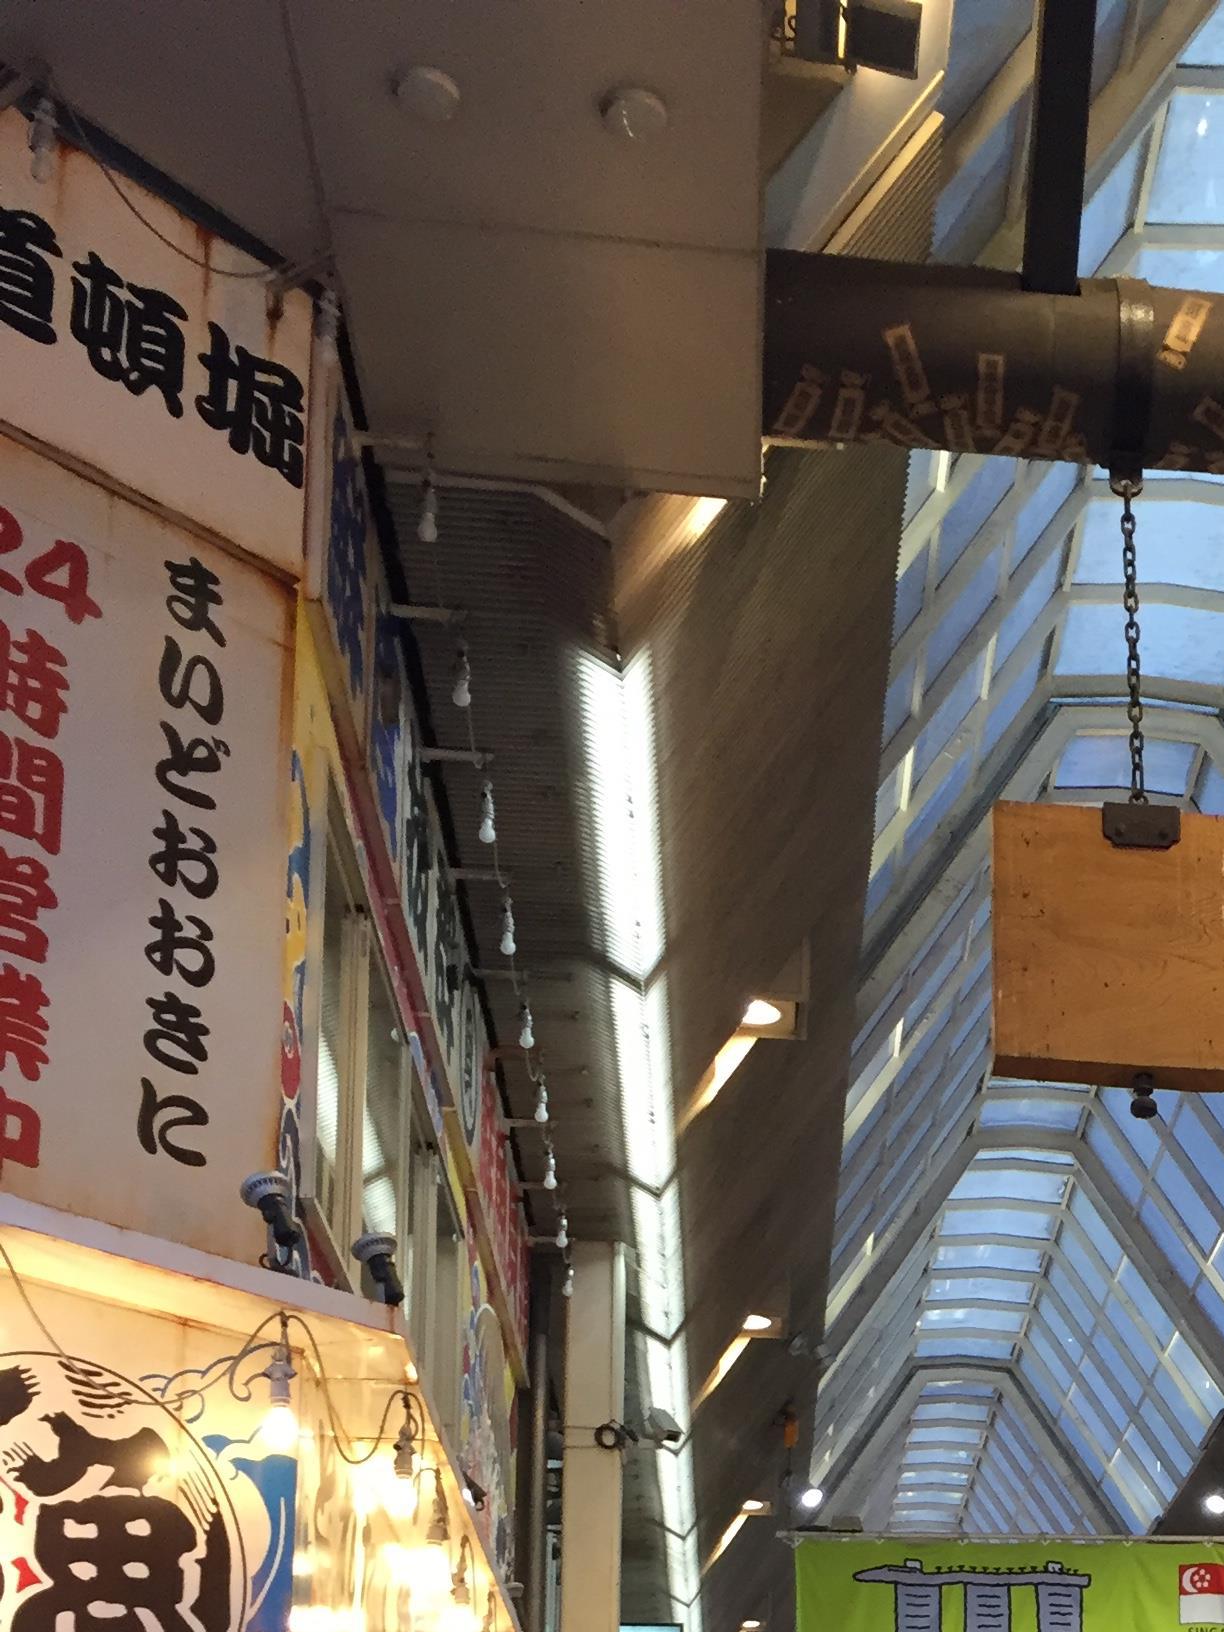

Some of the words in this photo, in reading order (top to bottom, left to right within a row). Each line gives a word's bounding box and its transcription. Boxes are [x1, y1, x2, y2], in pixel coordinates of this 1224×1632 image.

[136, 556, 231, 1166] まいどおおきに
